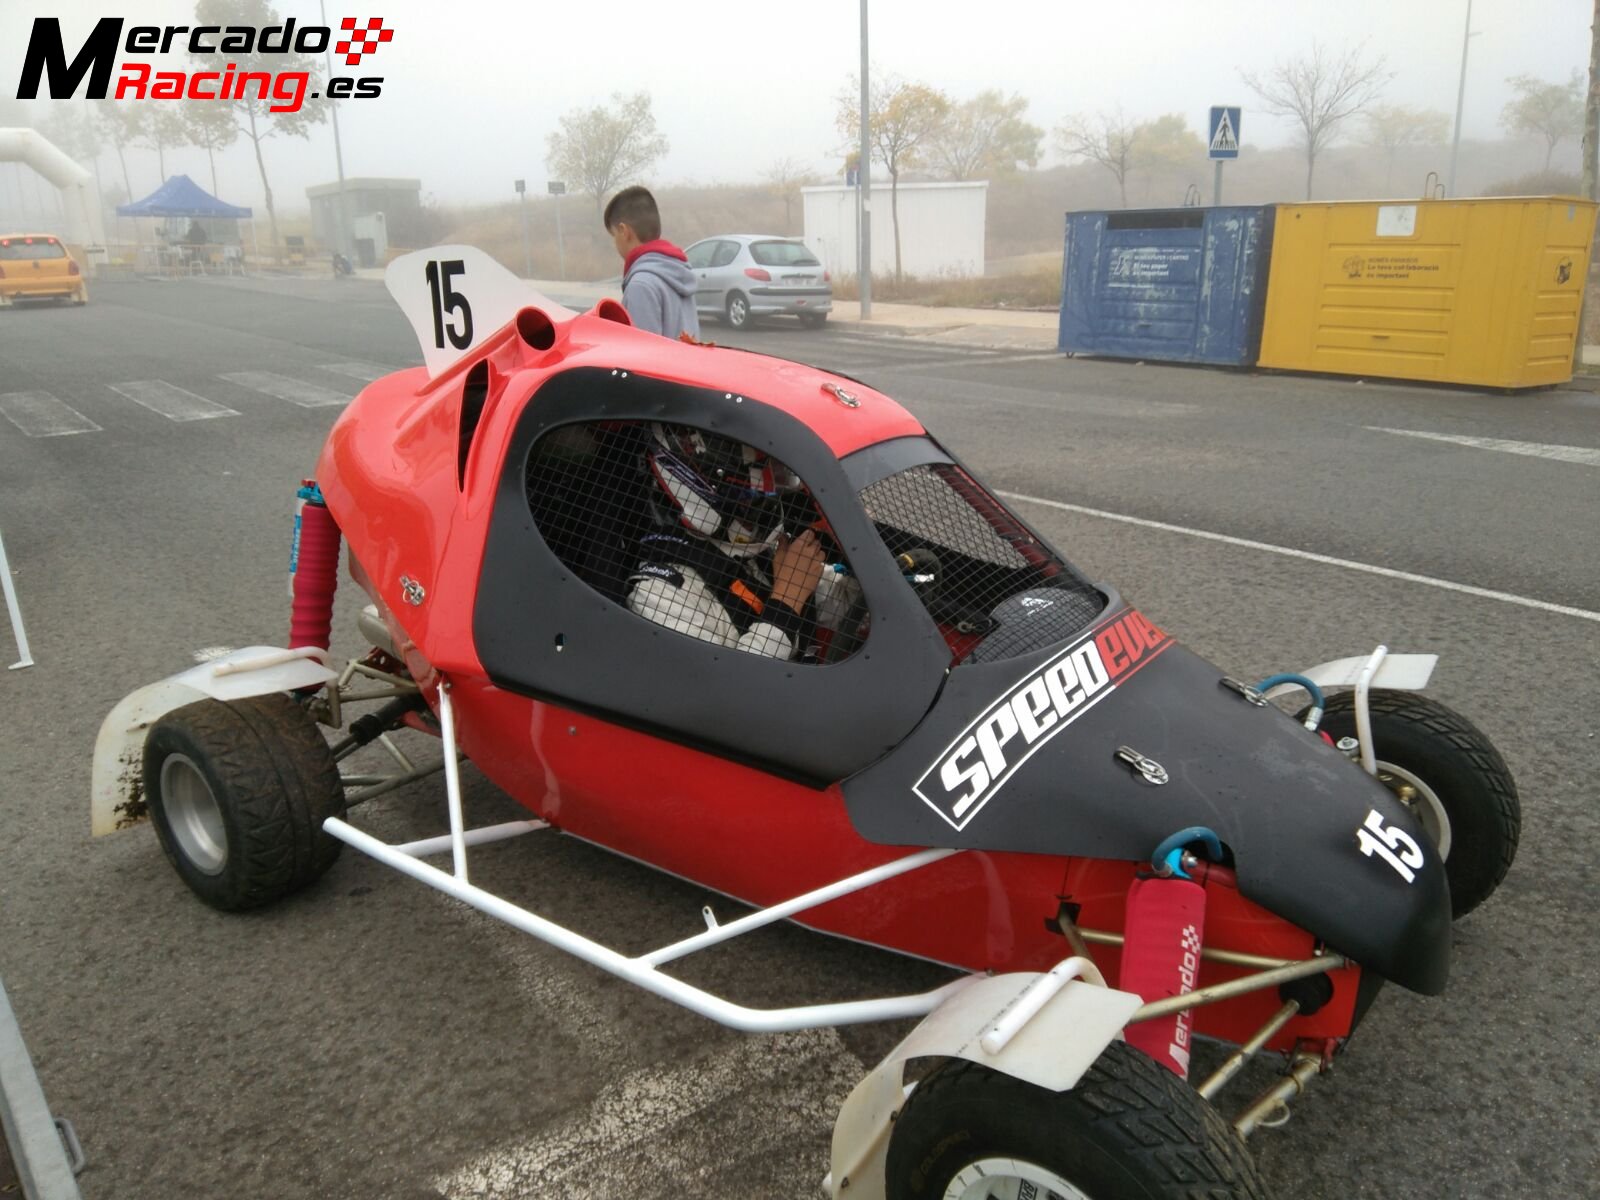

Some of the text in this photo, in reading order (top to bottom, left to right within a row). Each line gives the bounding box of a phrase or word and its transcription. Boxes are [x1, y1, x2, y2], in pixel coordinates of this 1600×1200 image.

[424, 259, 474, 351] 15
[1356, 808, 1425, 884] 15
[1169, 951, 1196, 1083] Merdo
